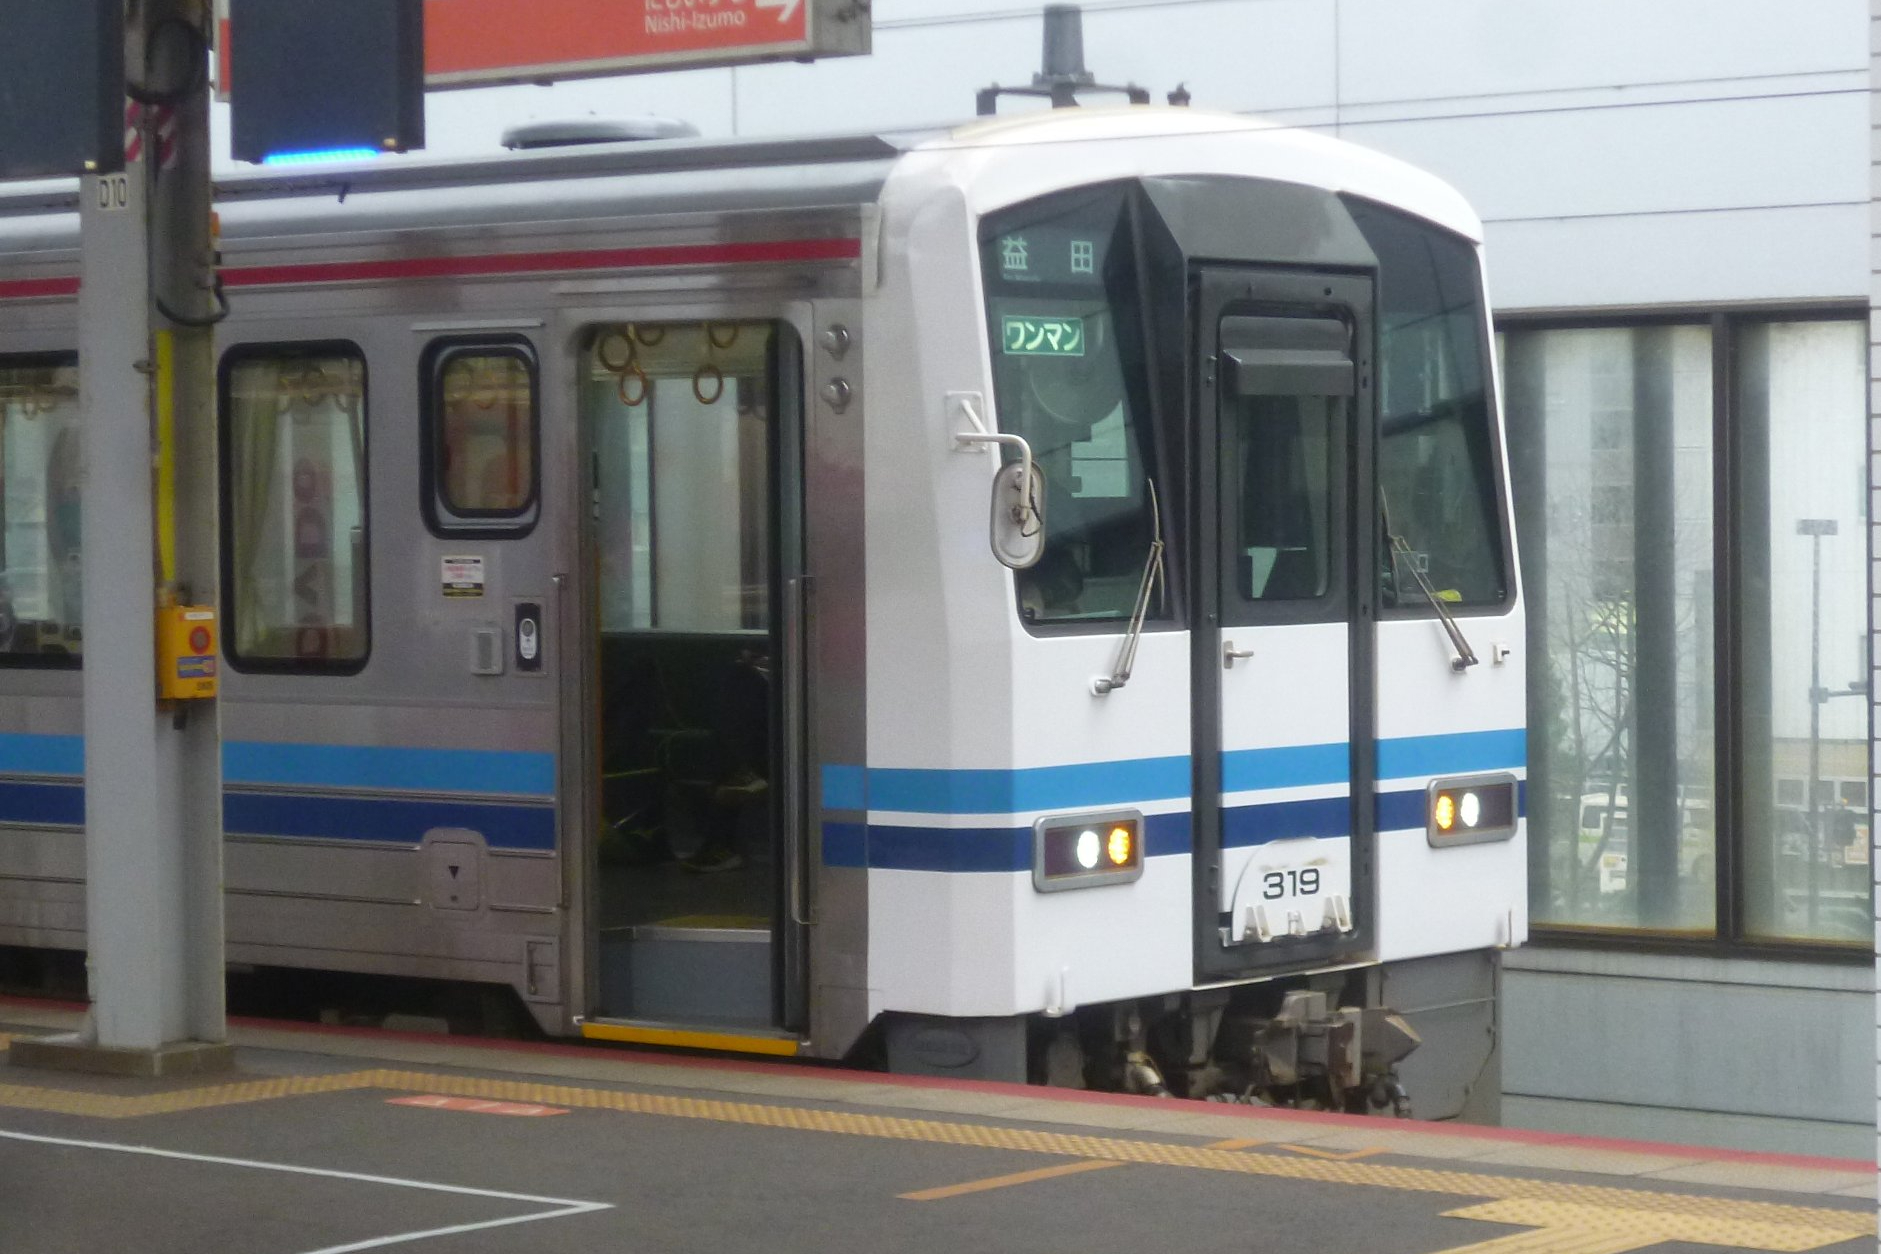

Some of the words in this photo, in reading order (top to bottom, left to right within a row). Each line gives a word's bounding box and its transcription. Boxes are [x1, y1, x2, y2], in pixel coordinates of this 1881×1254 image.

[645, 10, 746, 34] Nishi-Izumo
[1006, 320, 1081, 351] ワンマン
[1263, 868, 1320, 900] 319
